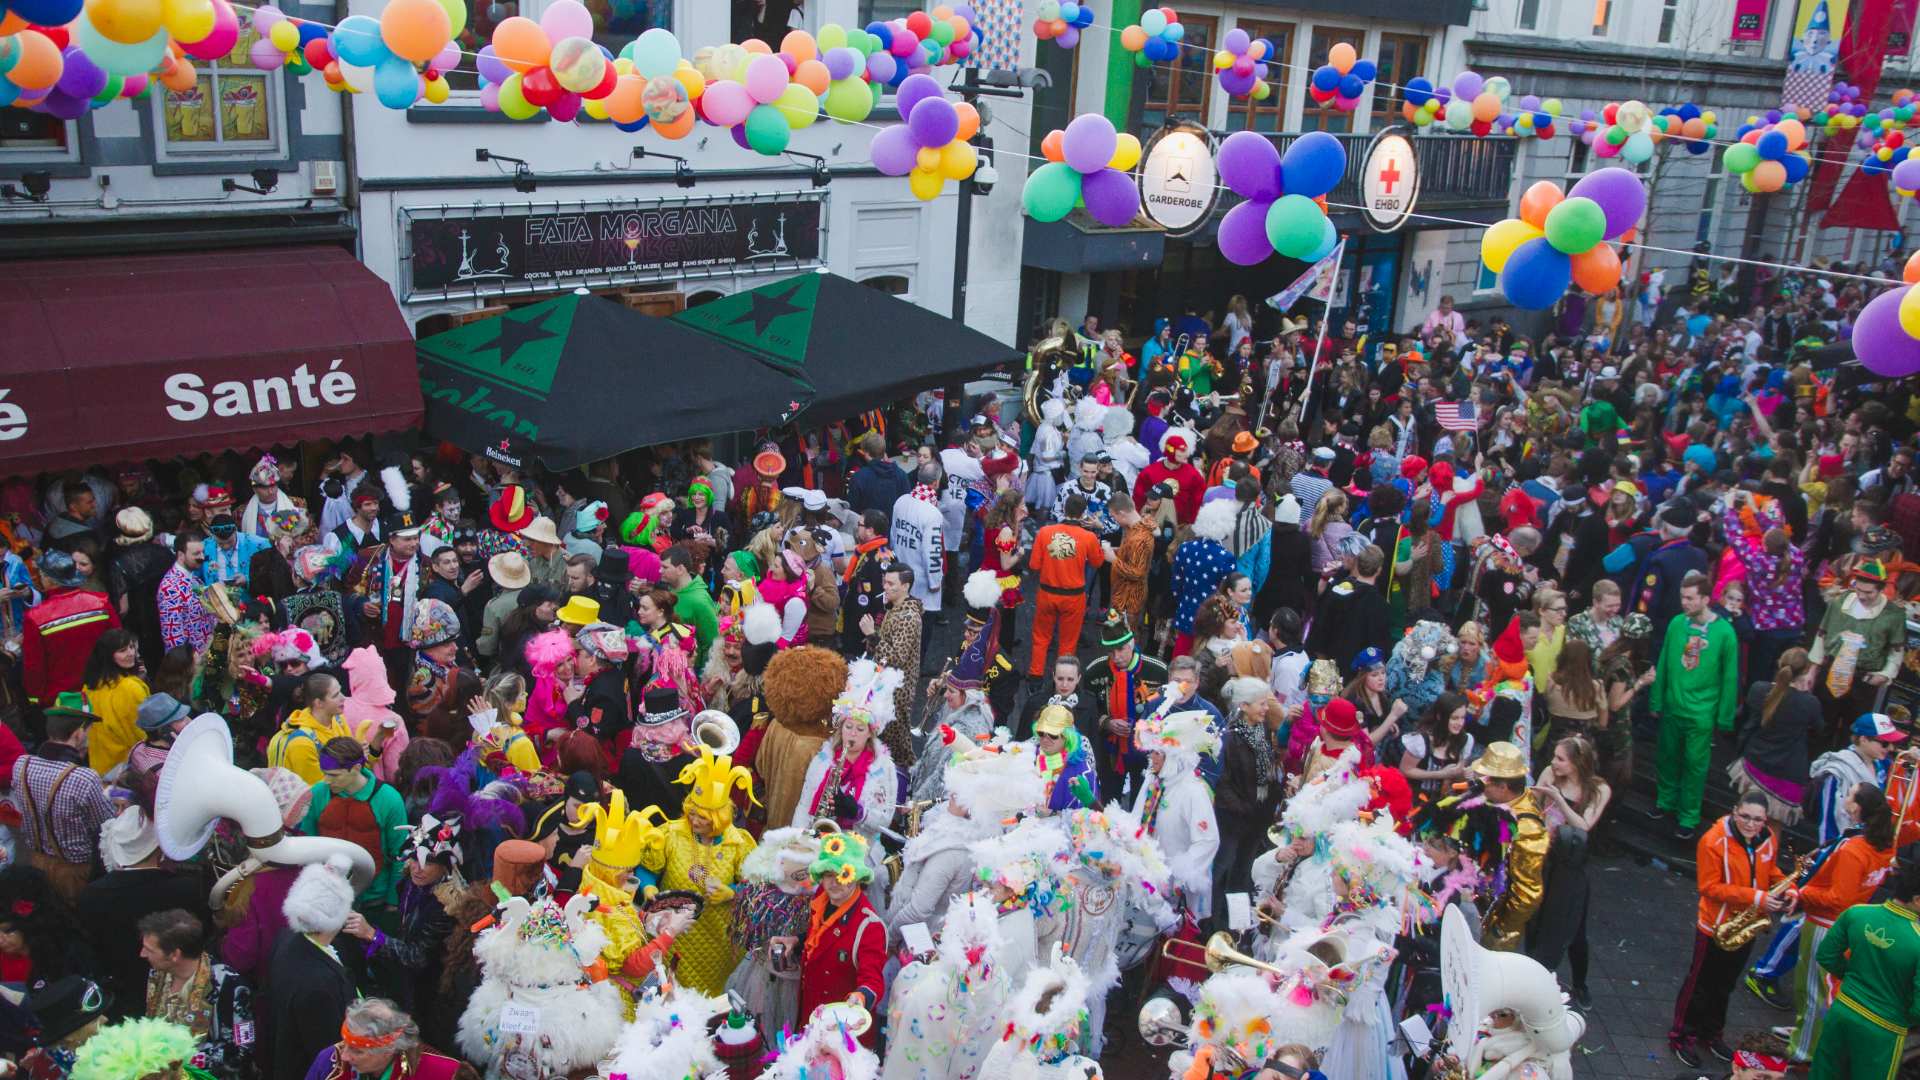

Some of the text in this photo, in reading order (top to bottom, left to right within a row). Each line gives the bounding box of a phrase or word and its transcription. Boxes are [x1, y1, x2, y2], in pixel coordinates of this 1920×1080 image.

[1149, 194, 1203, 208] GARDEROBE
[1375, 199, 1400, 210] EHBO
[525, 208, 737, 245] FATA MORGANA
[164, 359, 357, 421] Santé
[486, 446, 521, 467] Heineken
[896, 533, 917, 550] THE
